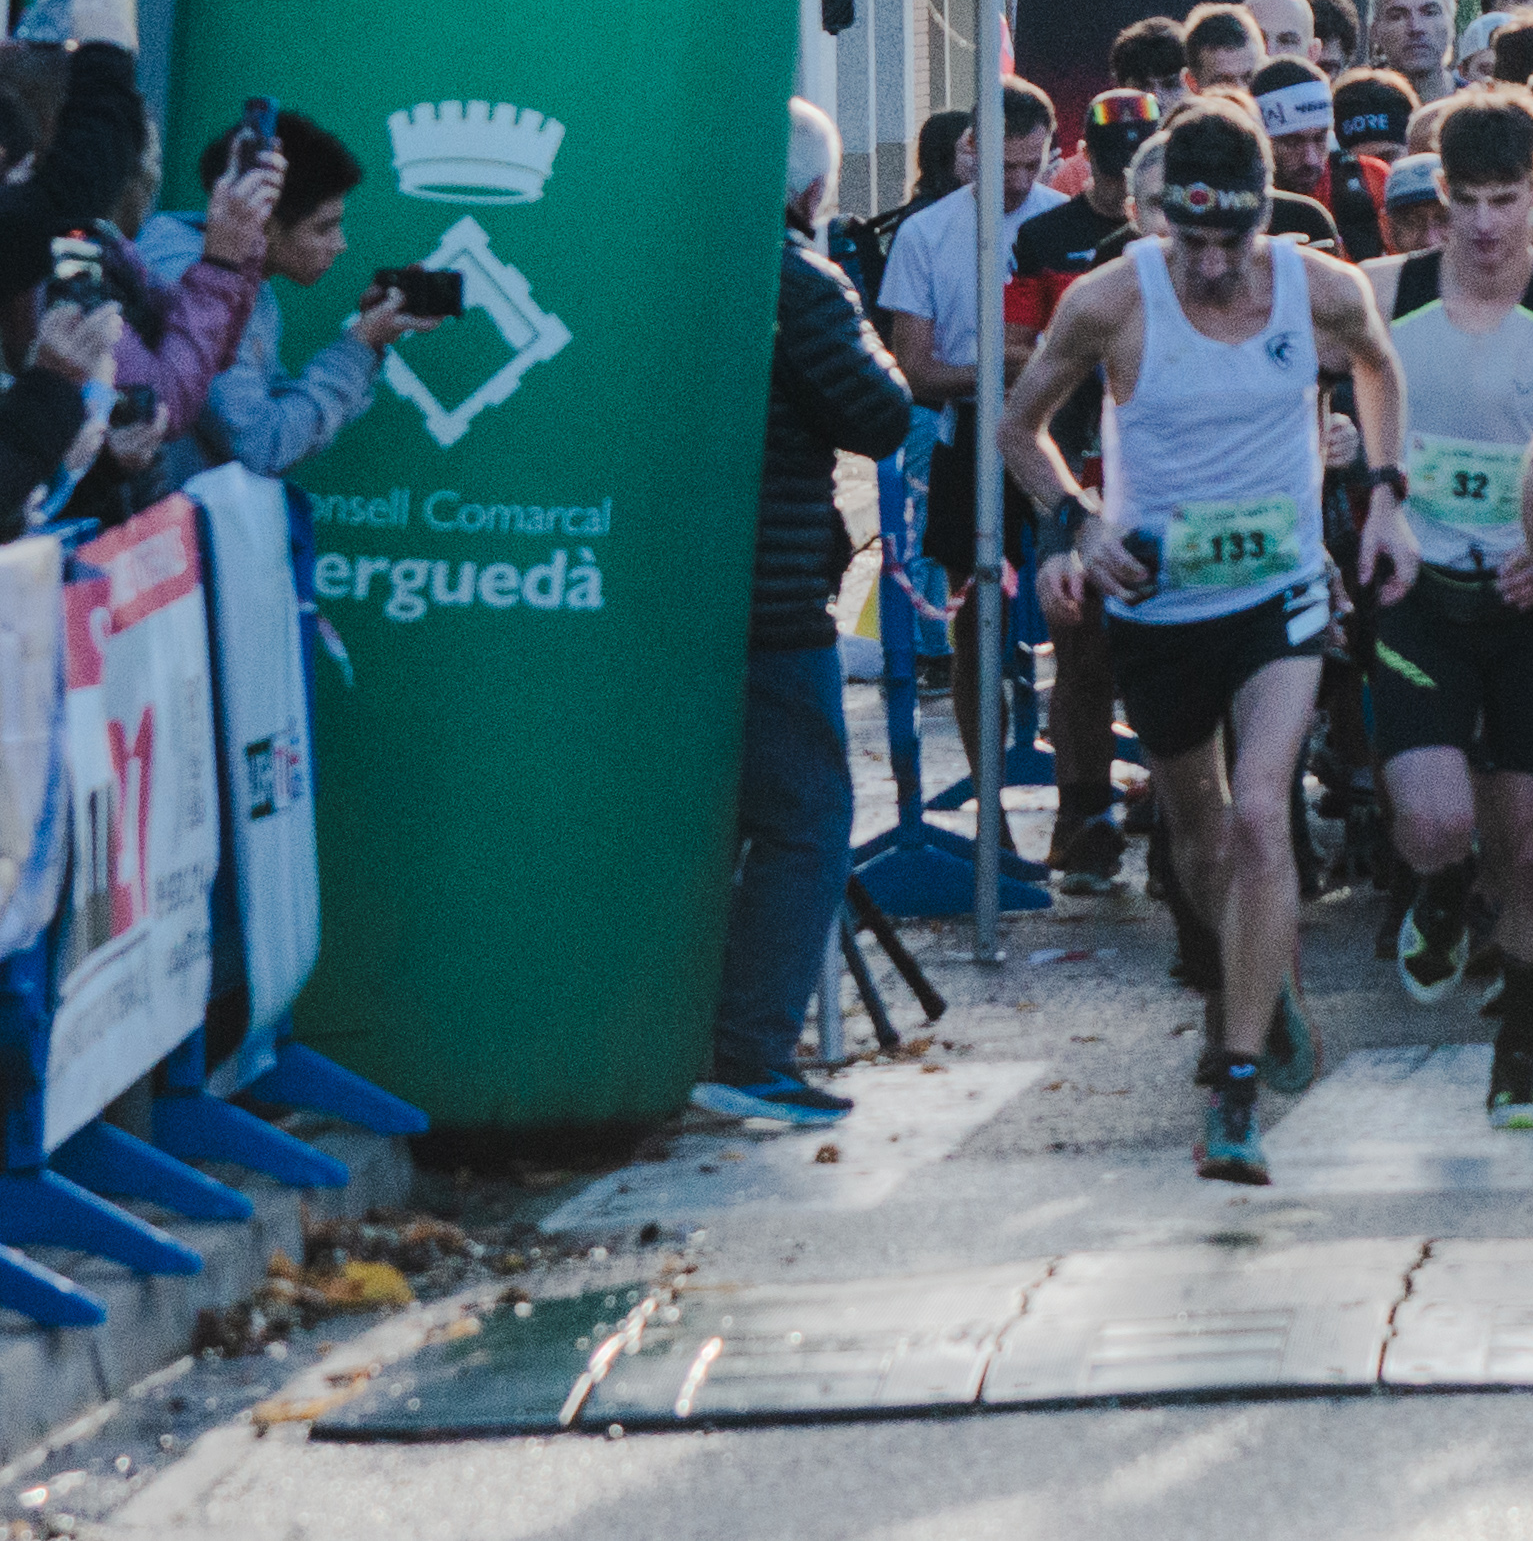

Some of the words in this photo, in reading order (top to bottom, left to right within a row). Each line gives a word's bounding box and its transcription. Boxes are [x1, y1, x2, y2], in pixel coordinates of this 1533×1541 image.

[1453, 469, 1489, 500] 32
[308, 486, 409, 528] onsell
[422, 489, 614, 537] Comarcal
[1212, 529, 1265, 563] 133
[312, 546, 605, 624] erguedà
